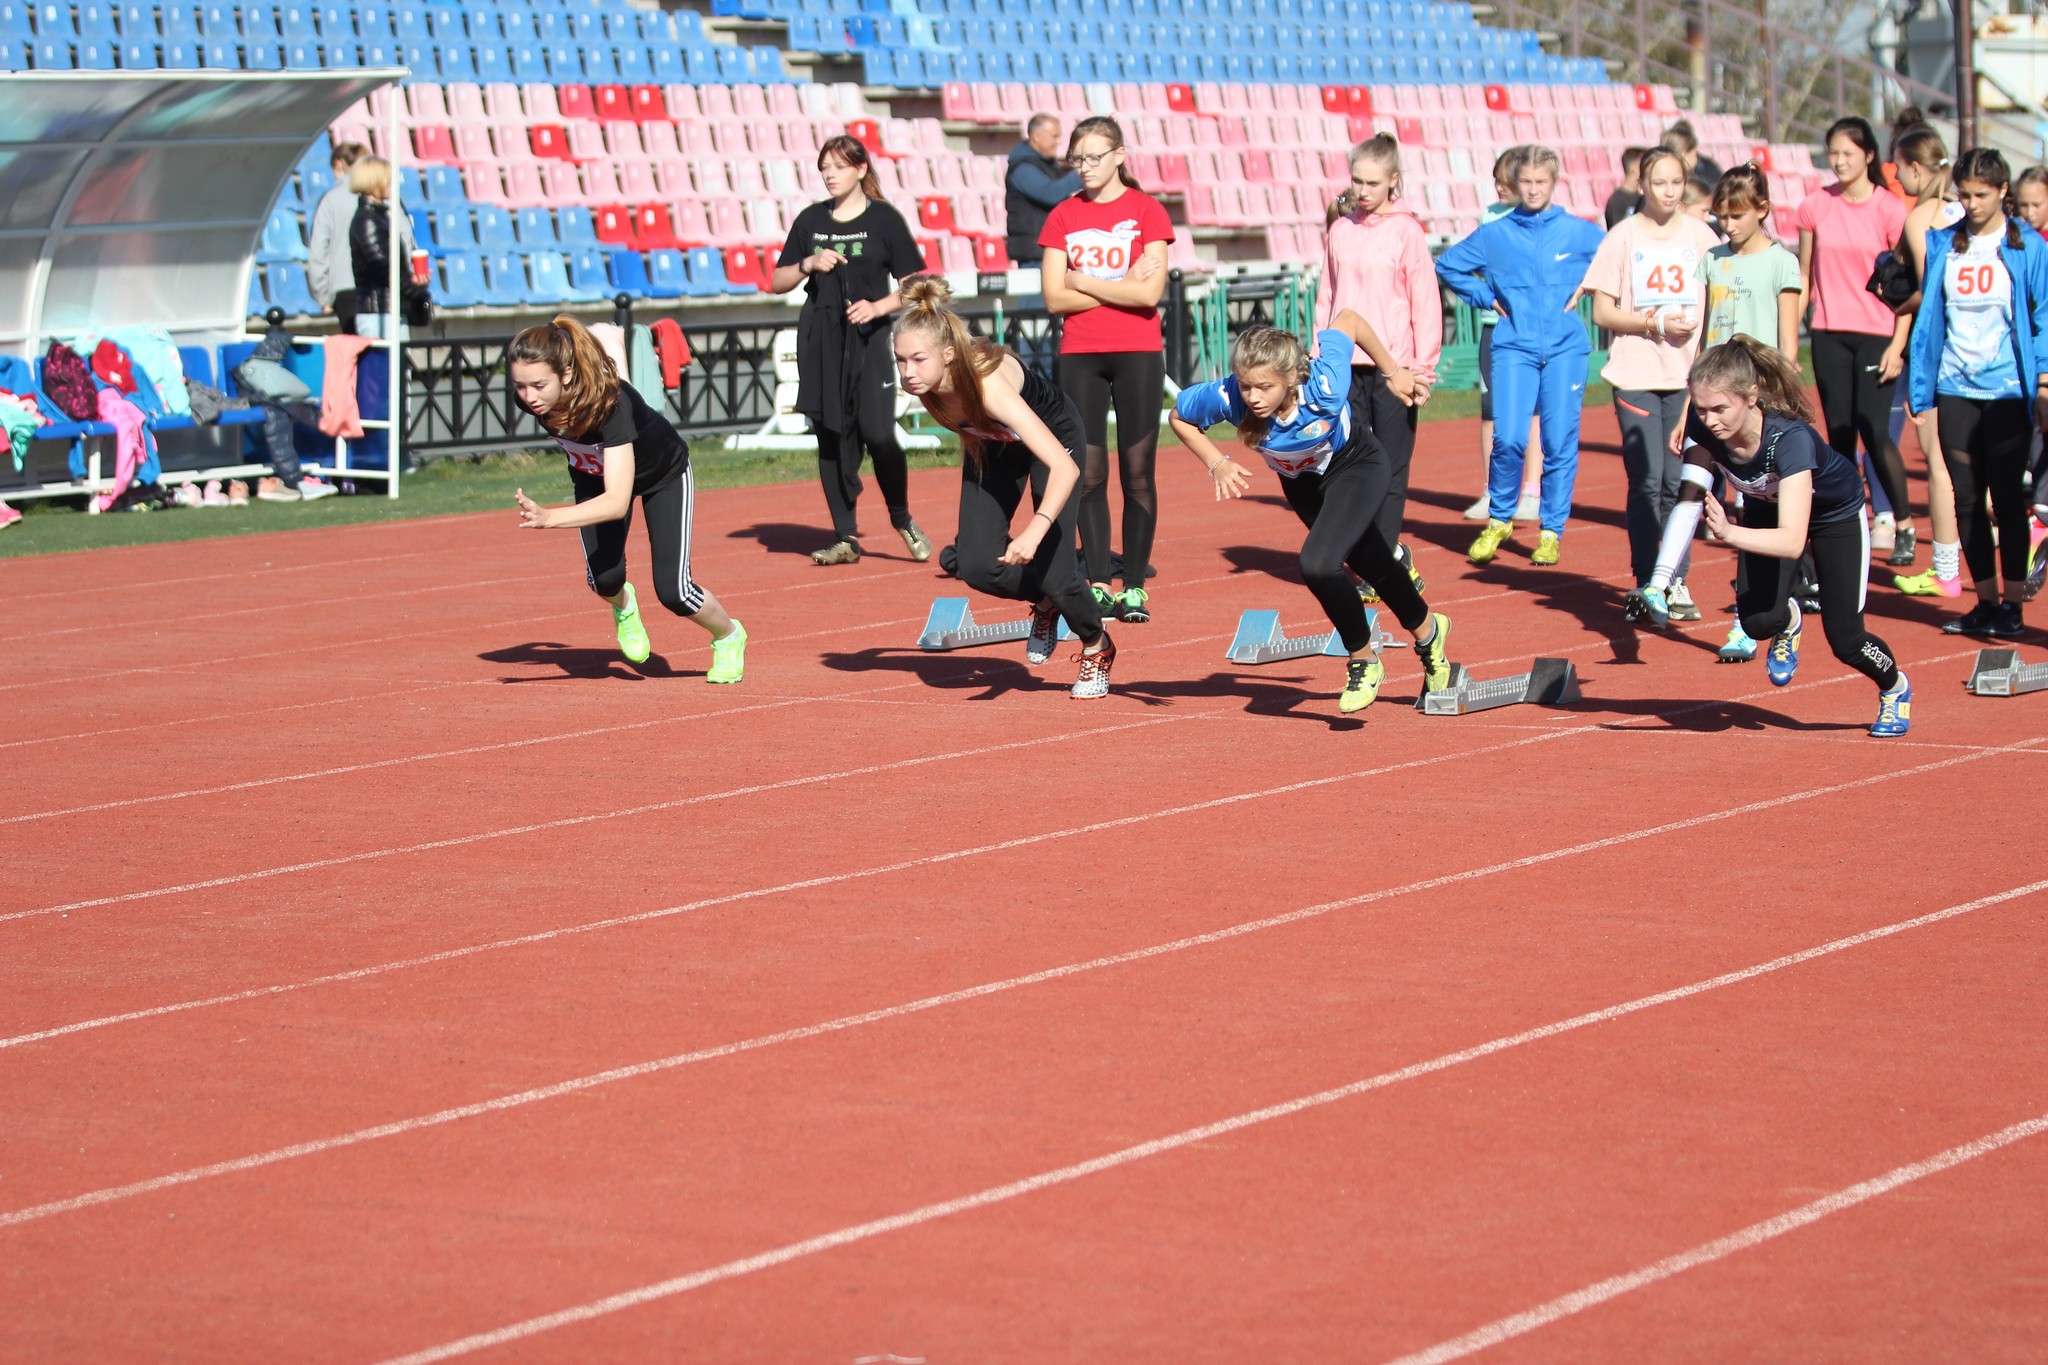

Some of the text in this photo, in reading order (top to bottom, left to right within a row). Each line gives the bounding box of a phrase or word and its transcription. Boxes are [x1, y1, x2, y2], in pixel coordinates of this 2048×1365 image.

[1071, 244, 1125, 269] 230
[1647, 264, 1685, 293] 43
[1957, 265, 1994, 295] 50
[568, 450, 605, 476] 25
